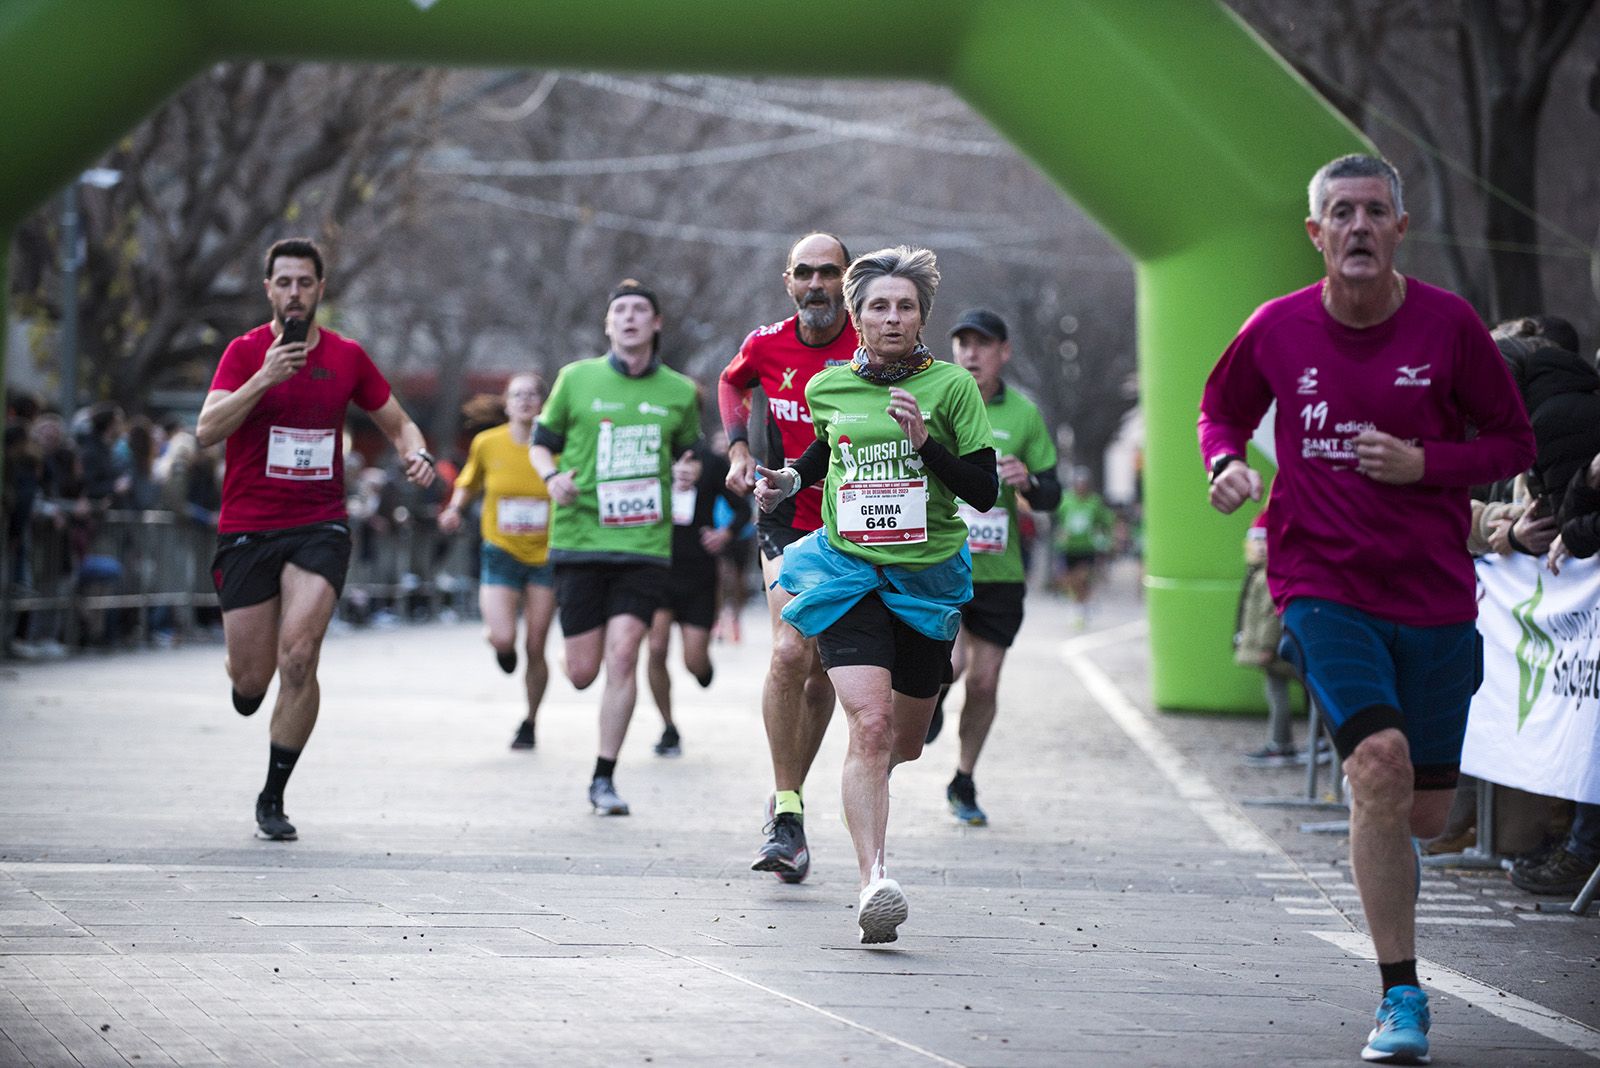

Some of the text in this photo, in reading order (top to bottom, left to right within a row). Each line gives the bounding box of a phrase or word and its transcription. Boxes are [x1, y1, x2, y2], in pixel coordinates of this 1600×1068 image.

[1300, 400, 1328, 431] 19
[857, 441, 897, 465] CURSA
[607, 499, 655, 513] 1004
[860, 504, 902, 516] GEMMA
[865, 516, 897, 529] 646
